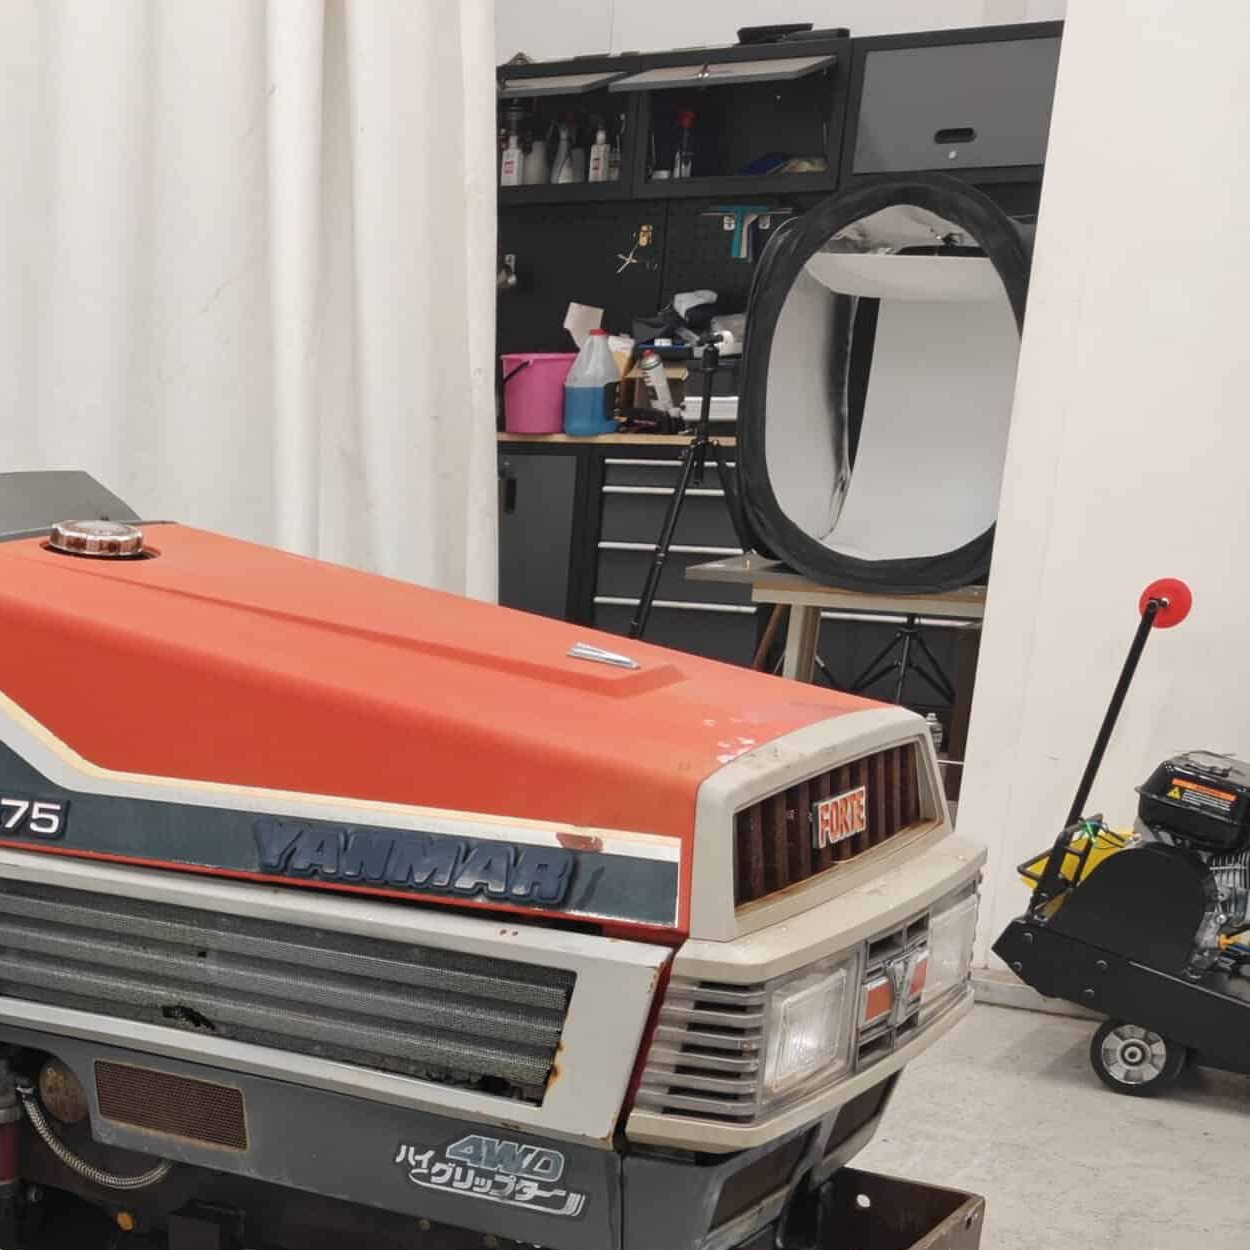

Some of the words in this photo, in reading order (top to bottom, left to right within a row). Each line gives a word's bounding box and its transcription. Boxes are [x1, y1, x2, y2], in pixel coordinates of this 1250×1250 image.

[818, 786, 866, 848] FORTE
[254, 820, 574, 901] YANMAR
[446, 1135, 565, 1182] 4WD
